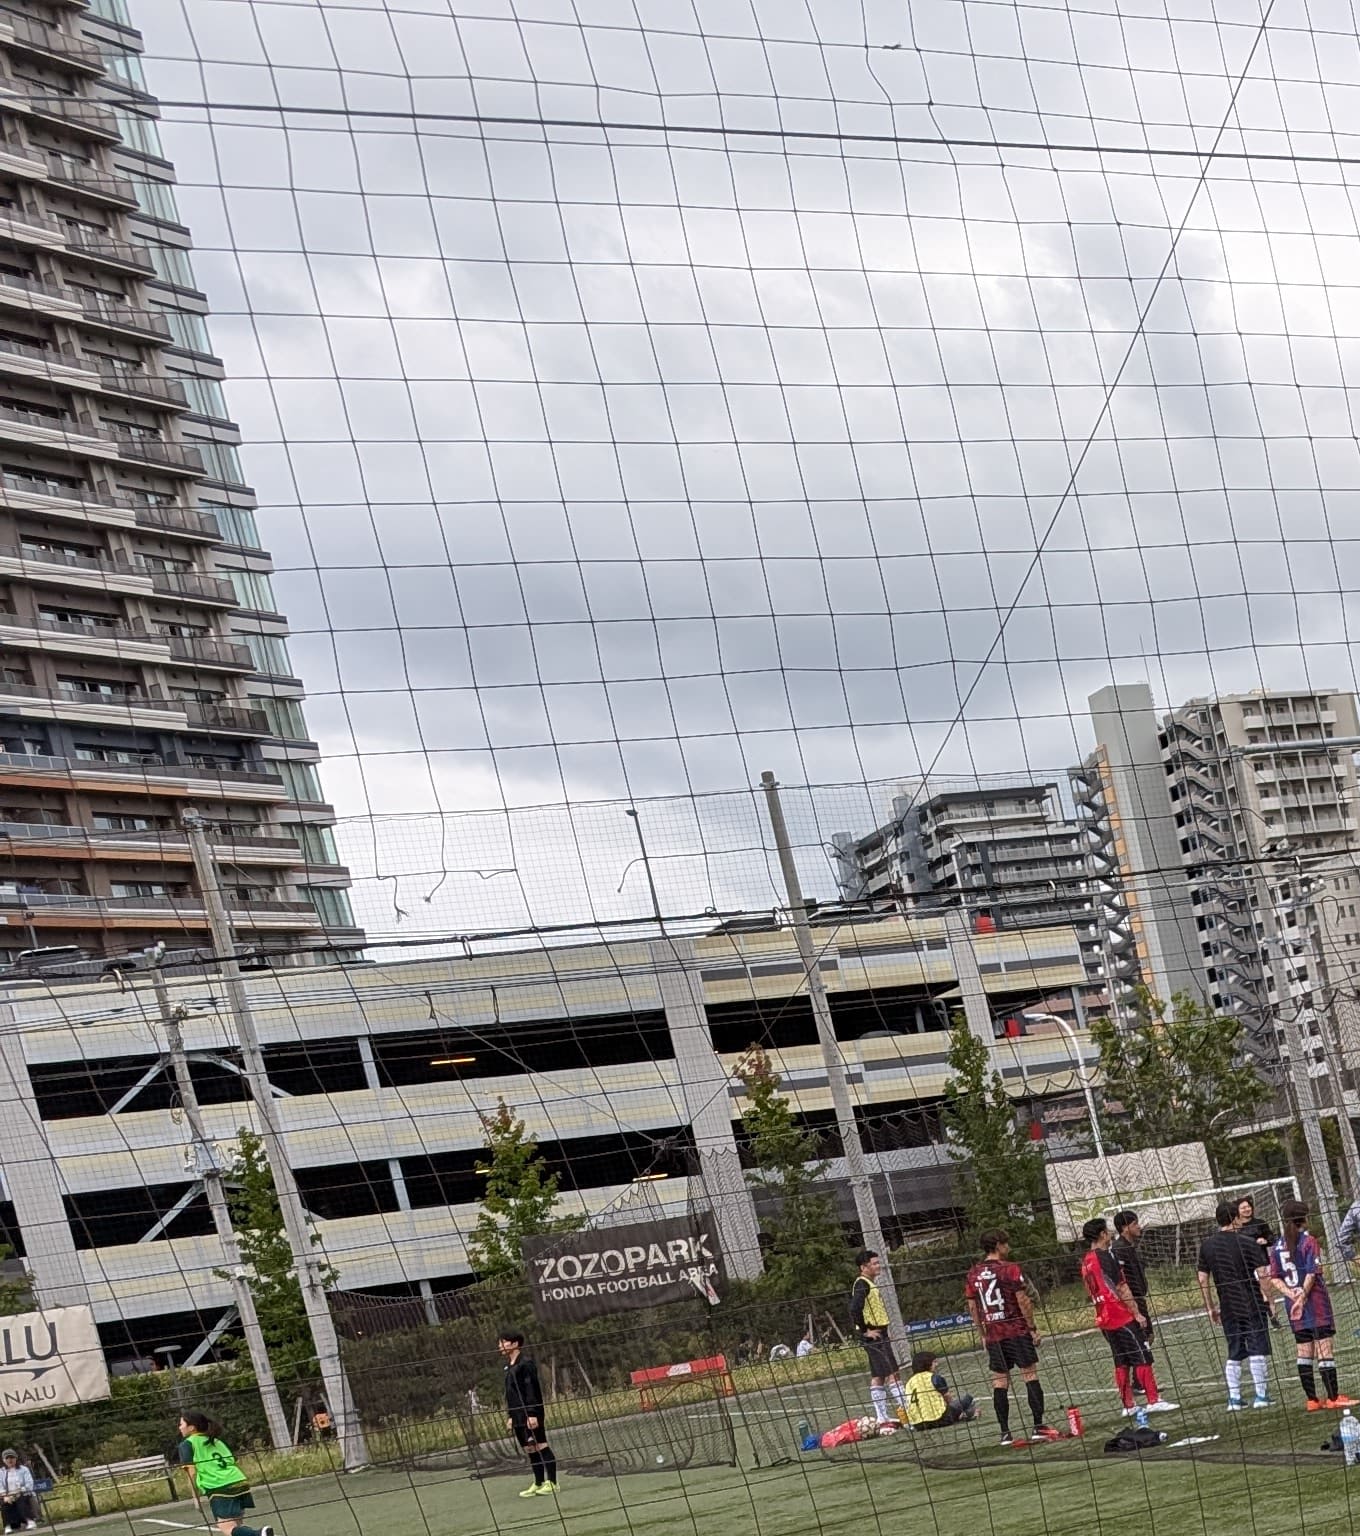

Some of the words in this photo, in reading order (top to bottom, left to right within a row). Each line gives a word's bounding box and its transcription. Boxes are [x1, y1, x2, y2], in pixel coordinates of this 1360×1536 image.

[538, 1233, 714, 1284] ZOZOPARK
[1279, 1250, 1299, 1287] 5
[541, 1283, 596, 1302] HONDA
[598, 1271, 676, 1295] FOOTBALL
[974, 1278, 1005, 1314] 14
[4, 1384, 56, 1406] NALU
[212, 1452, 228, 1470] 3
